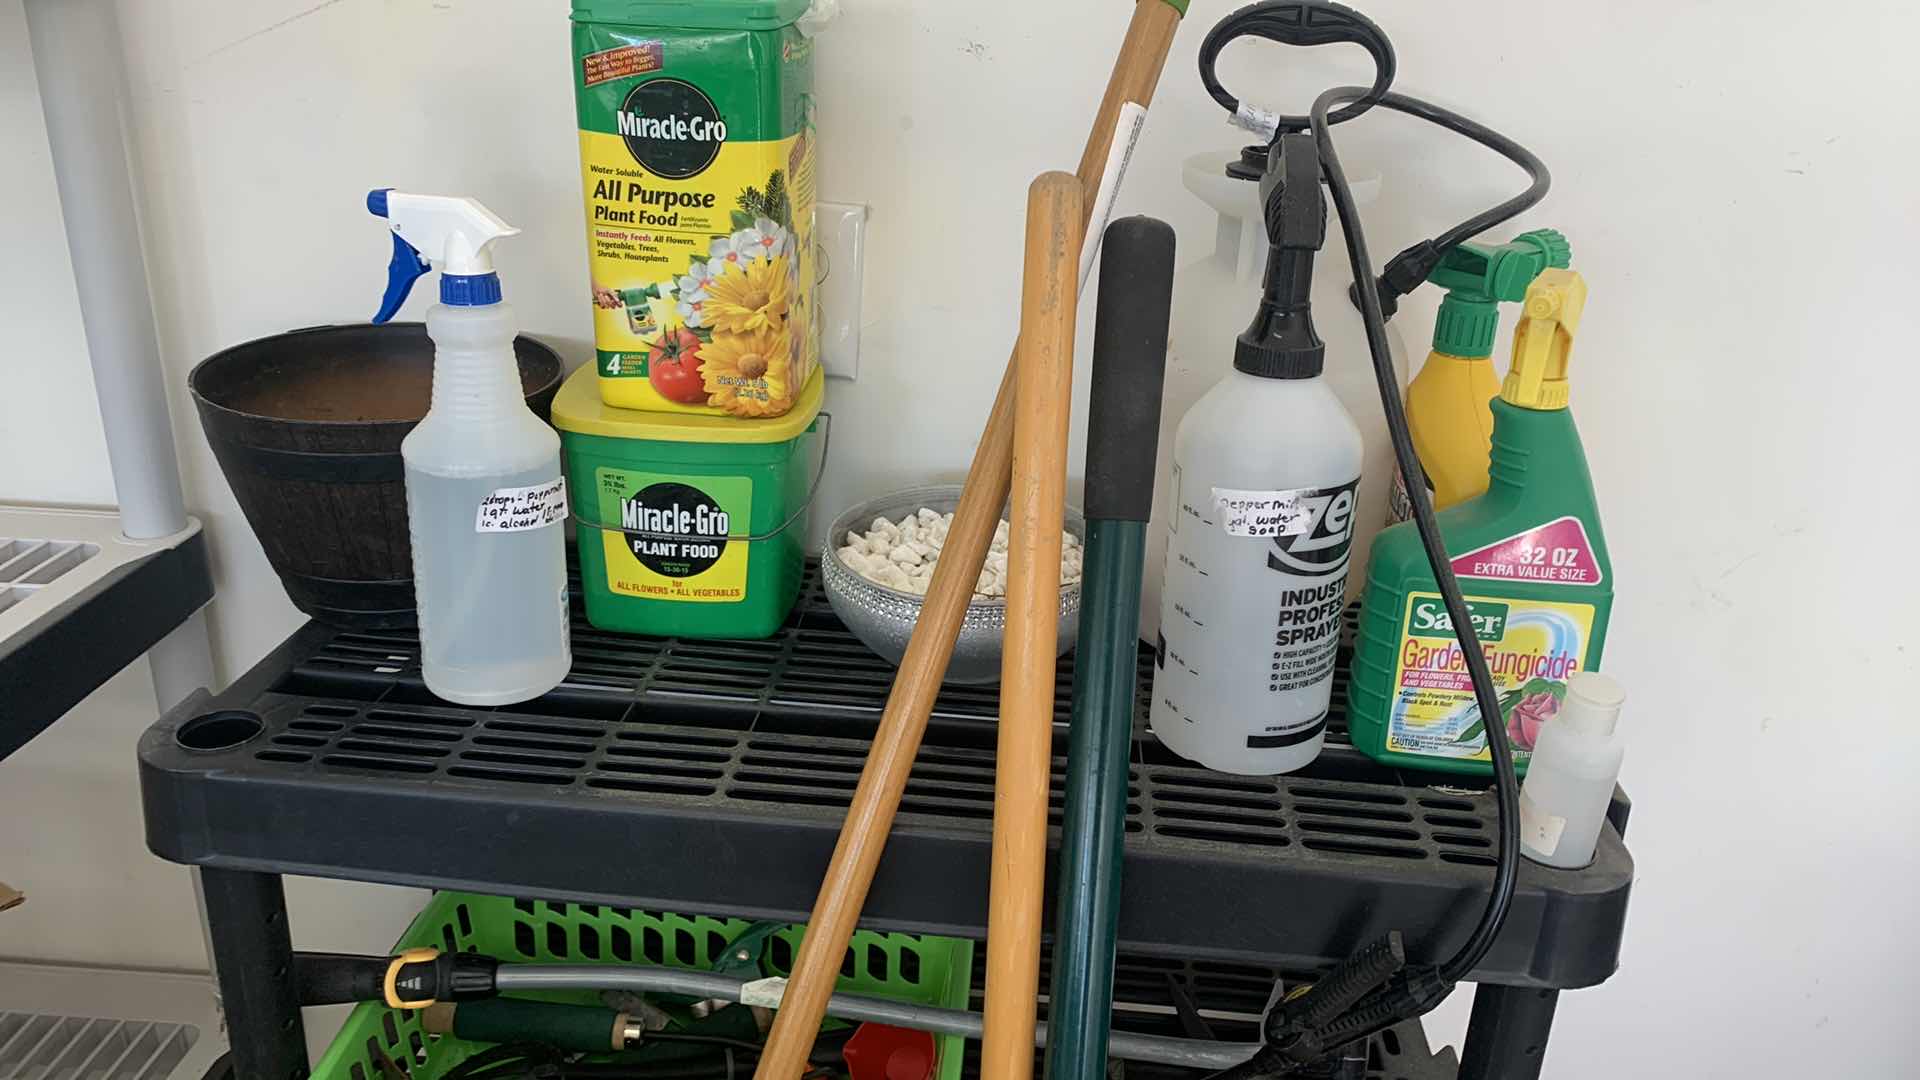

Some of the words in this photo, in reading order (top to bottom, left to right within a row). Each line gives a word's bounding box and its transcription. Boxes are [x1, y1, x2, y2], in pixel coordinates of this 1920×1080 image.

[585, 57, 601, 66] New
[609, 45, 651, 59] Improved!
[617, 110, 727, 142] Miracle-Gro
[590, 164, 614, 175] Water
[616, 168, 644, 178] Soluble
[593, 179, 622, 201] All
[628, 182, 716, 212] Purpose
[594, 205, 636, 223] Plant
[639, 210, 679, 226] Food
[595, 230, 629, 241] Instantly
[630, 232, 652, 241] Feeds
[654, 235, 664, 243] All
[665, 235, 697, 246] Flowers,
[596, 240, 637, 251] Vegetables,
[639, 244, 660, 253] Trees,
[597, 250, 622, 260] Shrubs,
[624, 253, 669, 263] Houseplants
[606, 354, 620, 375] 4
[513, 502, 546, 515] water
[621, 497, 730, 536] Miracle-Gro
[1256, 513, 1301, 526] water
[1248, 524, 1287, 538] soap
[633, 540, 679, 557] PLANT
[682, 544, 719, 559] FOOD
[1520, 547, 1546, 566] 32
[1552, 548, 1579, 567] OZ
[1474, 563, 1515, 576] EXTRA
[1517, 566, 1557, 579] VALUE
[1559, 568, 1587, 581] SIZE
[616, 581, 632, 590] ALL
[632, 583, 669, 595] FLOWERS
[677, 588, 690, 597] ALL
[693, 588, 741, 597] VEGETABLES
[672, 580, 684, 588] for
[1483, 644, 1577, 681] Fungicide
[1280, 673, 1292, 681] USE
[1404, 671, 1419, 679] FOR
[1420, 673, 1454, 681] FLOWERS,
[1279, 682, 1298, 691] GREAT
[1420, 679, 1464, 689] VEGETABLES
[1391, 736, 1420, 747] CAUTION
